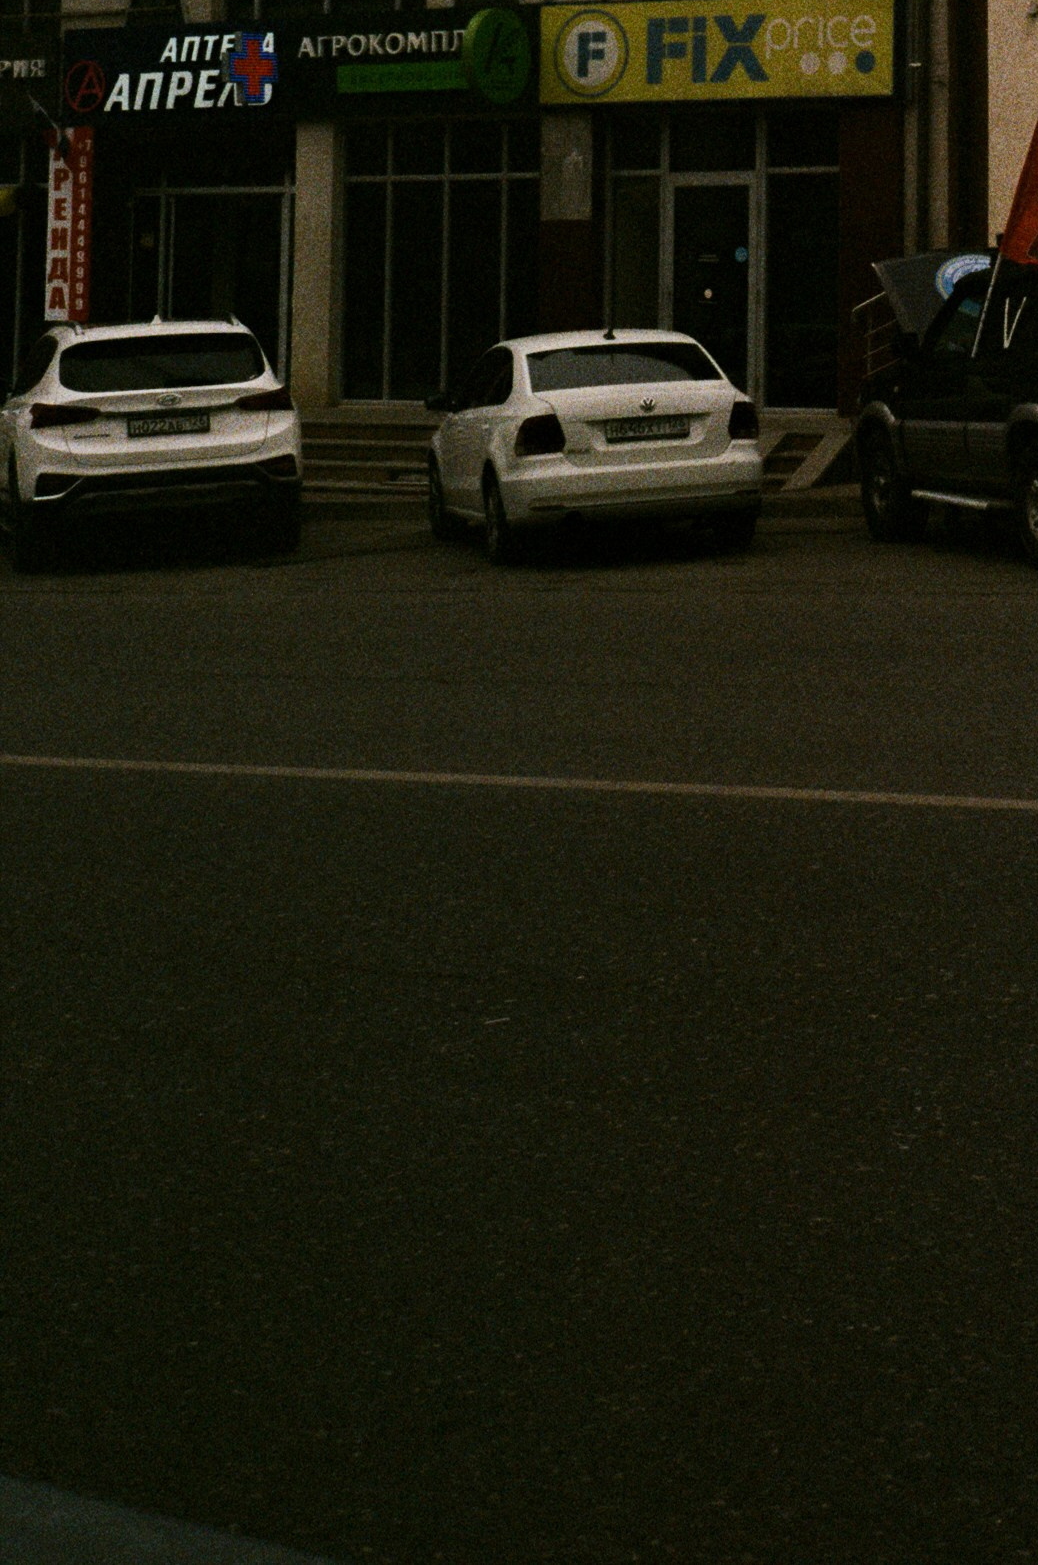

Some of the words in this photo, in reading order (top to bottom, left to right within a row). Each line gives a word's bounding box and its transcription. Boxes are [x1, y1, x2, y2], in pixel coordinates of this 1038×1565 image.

[159, 32, 275, 63] АПТЕА
[646, 14, 770, 84] FIX
[764, 14, 877, 59] price
